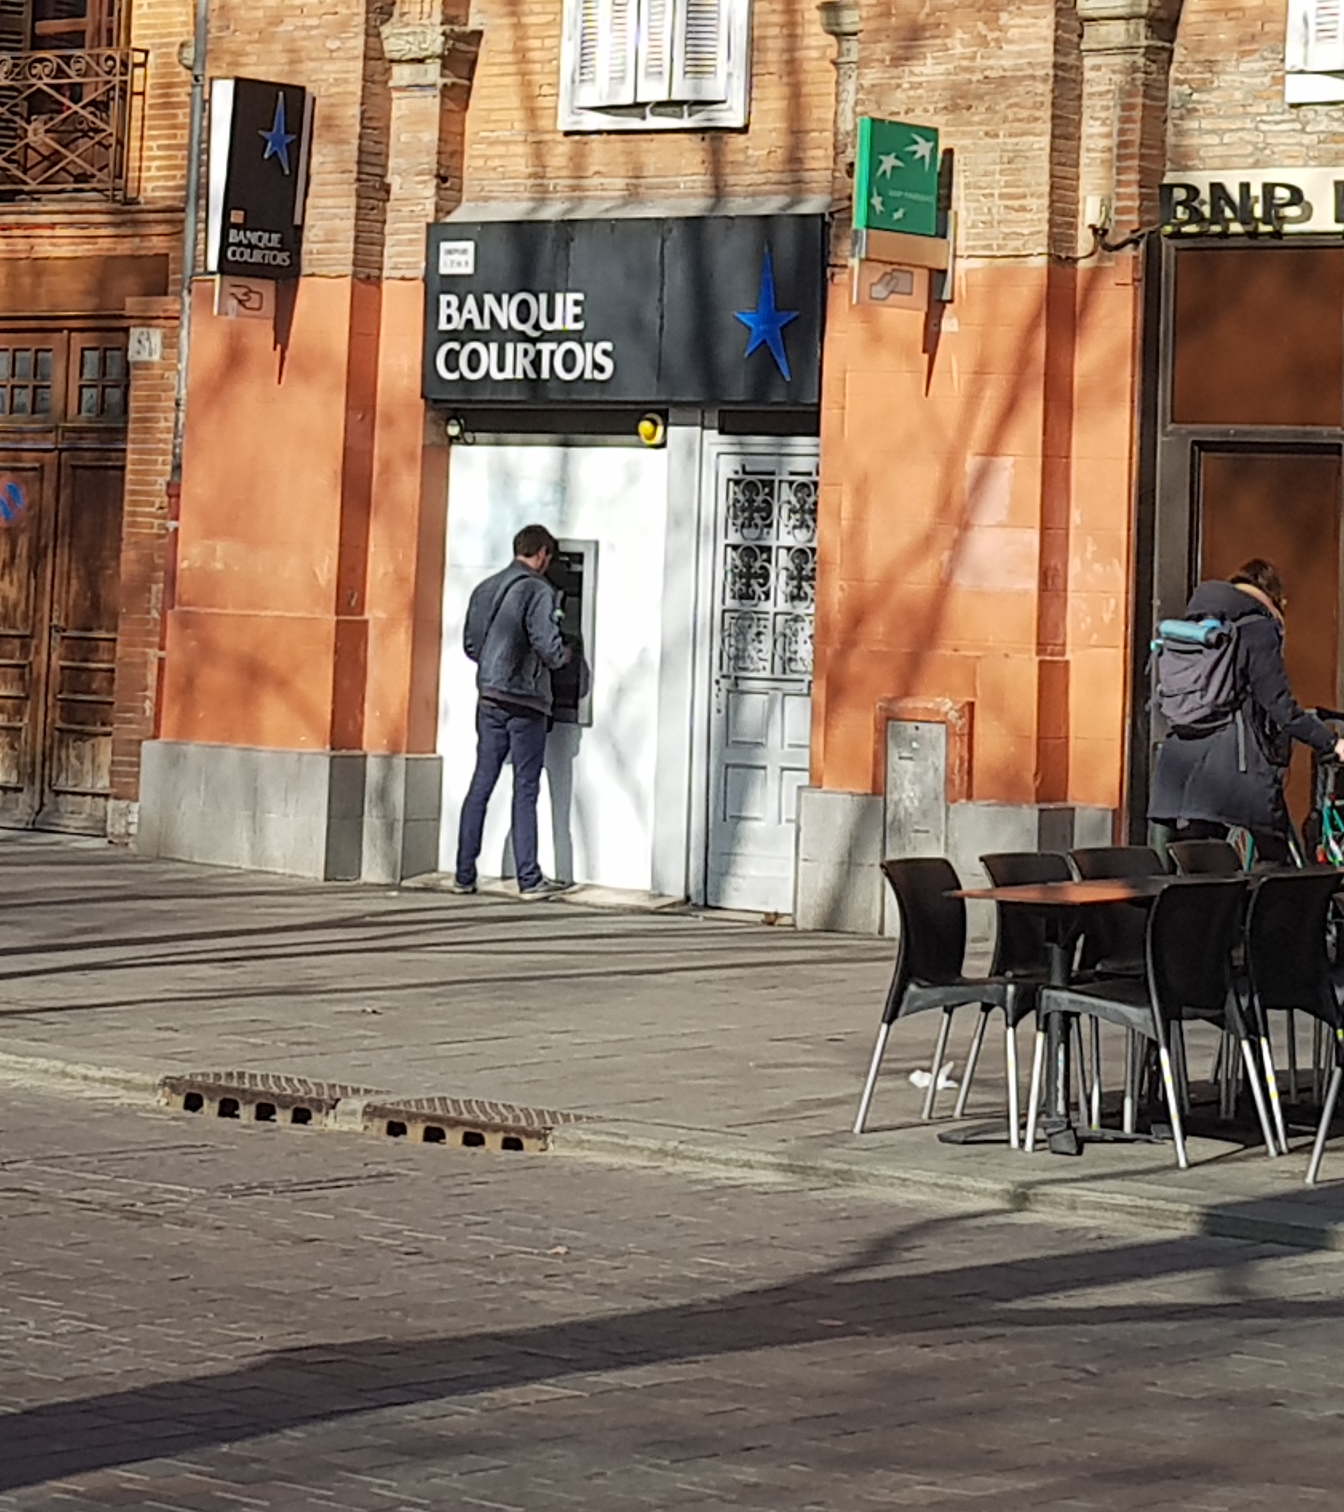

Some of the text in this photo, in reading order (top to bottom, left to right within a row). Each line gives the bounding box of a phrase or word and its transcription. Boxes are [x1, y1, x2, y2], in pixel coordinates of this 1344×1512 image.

[1158, 181, 1305, 227] BNP
[226, 246, 291, 267] COURTOIS
[228, 228, 282, 248] BANQUE
[438, 291, 586, 338] BANQUE
[435, 340, 615, 381] COURTOIS
